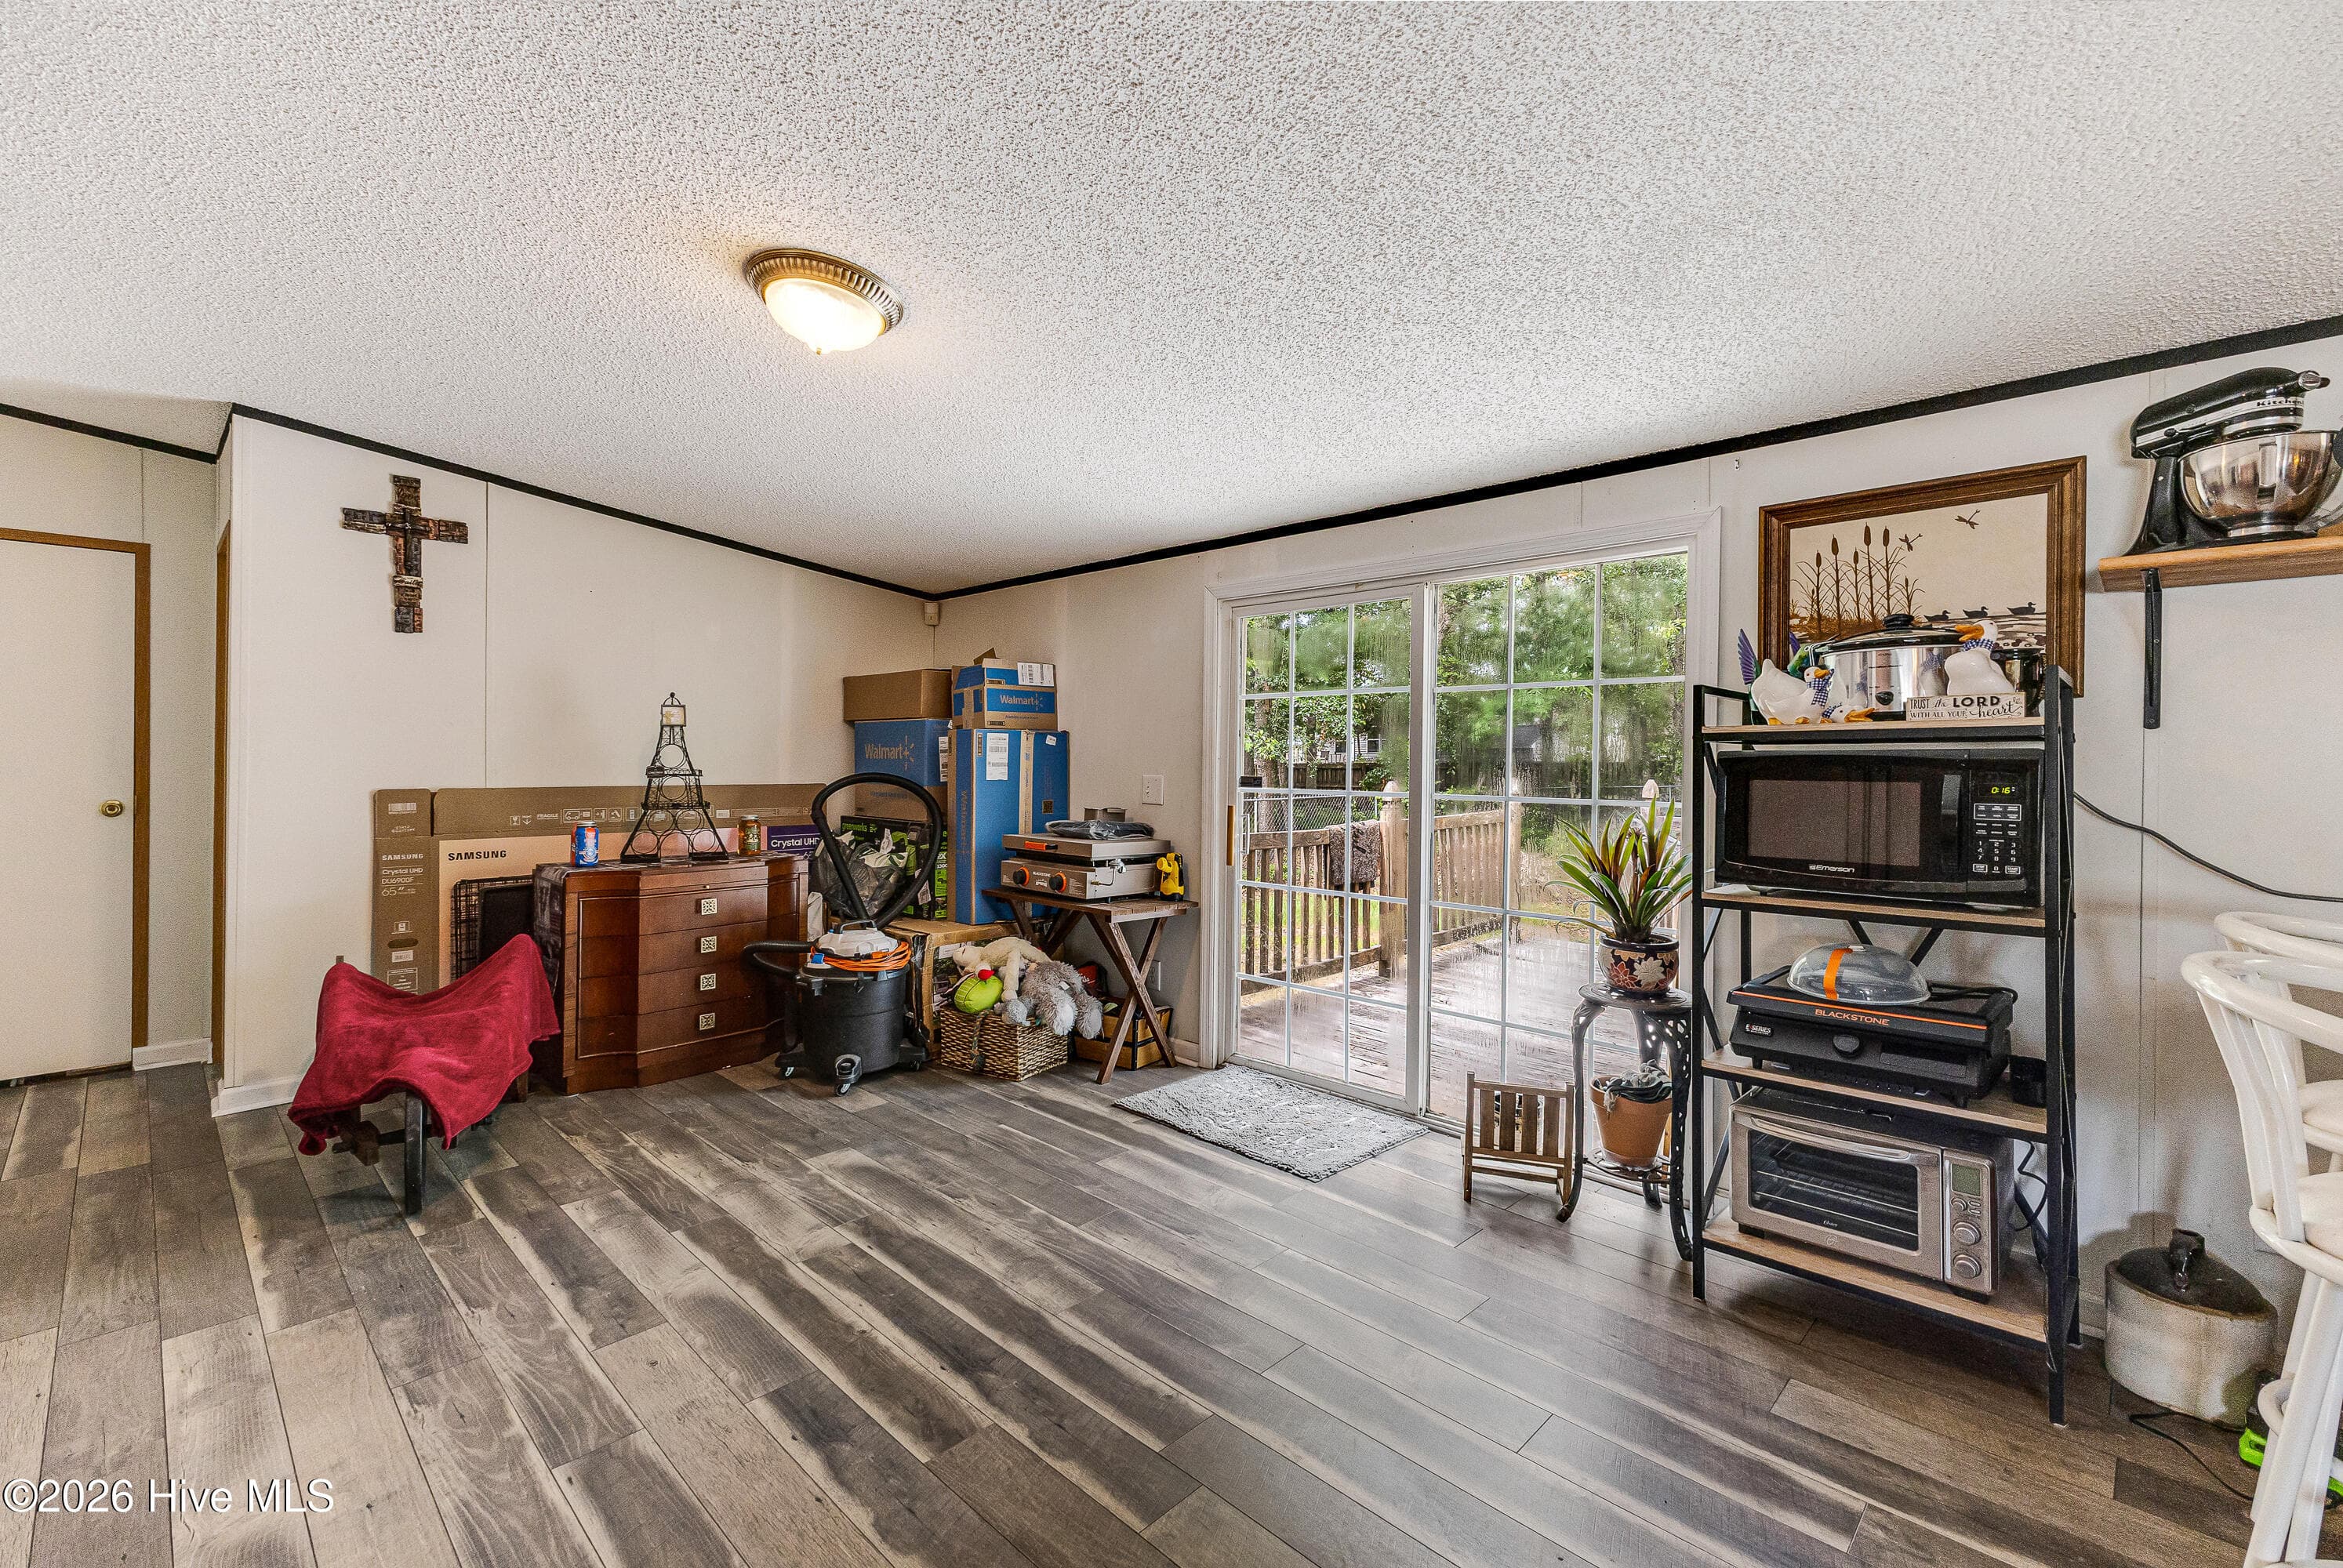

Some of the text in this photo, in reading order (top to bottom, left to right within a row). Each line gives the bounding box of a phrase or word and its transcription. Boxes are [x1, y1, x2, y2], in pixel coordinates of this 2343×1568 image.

[1000, 695, 1034, 706] Walmart
[1910, 699, 1930, 709] TRUST
[1952, 696, 2000, 707] LORD
[1910, 710, 1930, 718] WITH
[1969, 701, 2023, 718] heart
[865, 743, 903, 760] Walmart
[771, 838, 802, 849] Crystal
[449, 850, 507, 861] SAMSUNG
[1816, 865, 1855, 873] Emerson
[1814, 1008, 1890, 1026] BLACKSTONE
